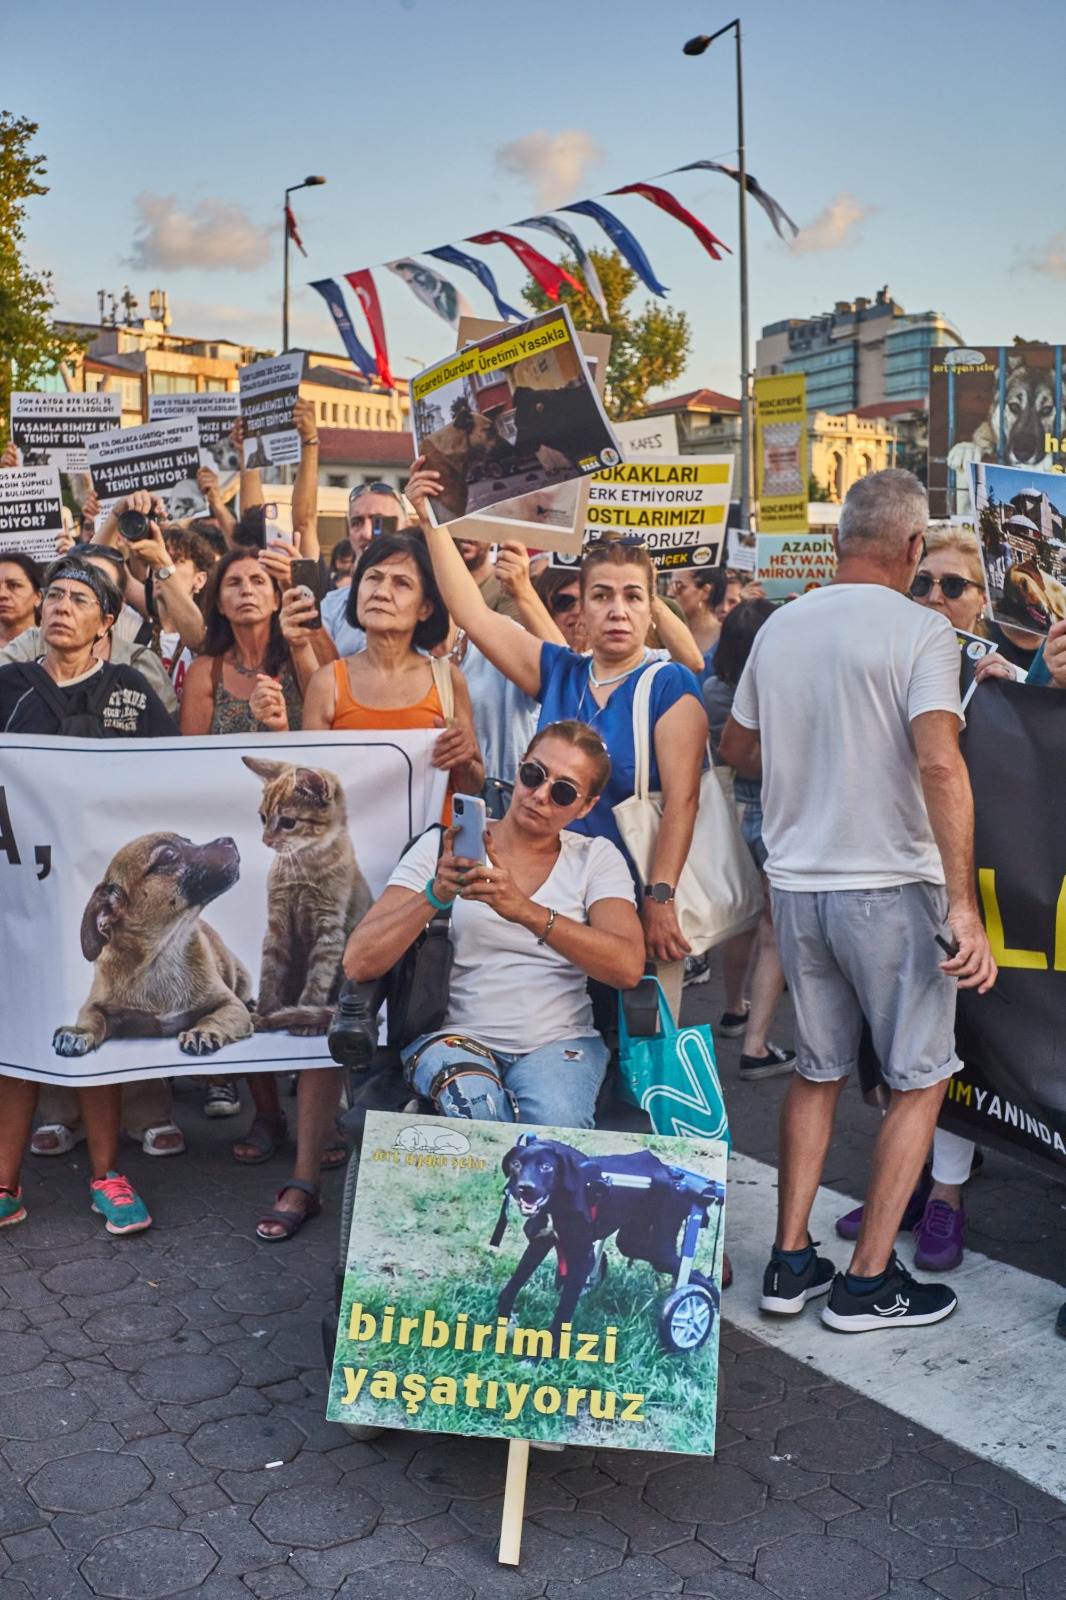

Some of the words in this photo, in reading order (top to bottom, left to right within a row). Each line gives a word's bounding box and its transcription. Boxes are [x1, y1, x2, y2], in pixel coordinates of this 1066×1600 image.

[414, 373, 443, 396] Ticareti
[443, 358, 475, 380] Durdur
[479, 345, 519, 371] Üretimi
[519, 326, 566, 353] Yasakla
[42, 397, 64, 405] AYDA
[17, 405, 63, 413] CİNAYETİYLE
[66, 405, 114, 413] KATLEDİLDİ!
[13, 422, 96, 433] YAŞAMLARIMIZI
[99, 420, 119, 432] KİM
[247, 414, 265, 431] TEHDİT
[266, 411, 292, 427] EDİYOR?
[24, 432, 60, 444] TEHDİT
[101, 441, 110, 449] YIL
[111, 436, 138, 448] ONLARCA
[167, 425, 193, 435] NEFRET
[630, 434, 662, 450] KAFES
[99, 445, 125, 457] CİNAYETİ
[92, 458, 174, 481] YAŞAMLARIMIZI
[176, 450, 199, 466] KİM
[12, 471, 37, 480] KADIN
[106, 476, 139, 493] TEHDİT
[143, 468, 187, 487] EDİYOR?
[21, 478, 53, 488] ŞÜPHELİ
[5, 488, 45, 498] BULUNDU!
[589, 488, 617, 501] ERK
[621, 487, 703, 503] ETMİYORUZ
[35, 499, 59, 513] KİM
[0, 515, 46, 529] DİYOR?
[587, 507, 705, 526] OSTLARIMIZI
[650, 553, 688, 567] RİÇEK
[758, 566, 826, 579] MİROVAN
[373, 1148, 400, 1165] dört
[348, 1302, 618, 1364] birbirimizi
[341, 1366, 646, 1423] yaşatıyoruz
